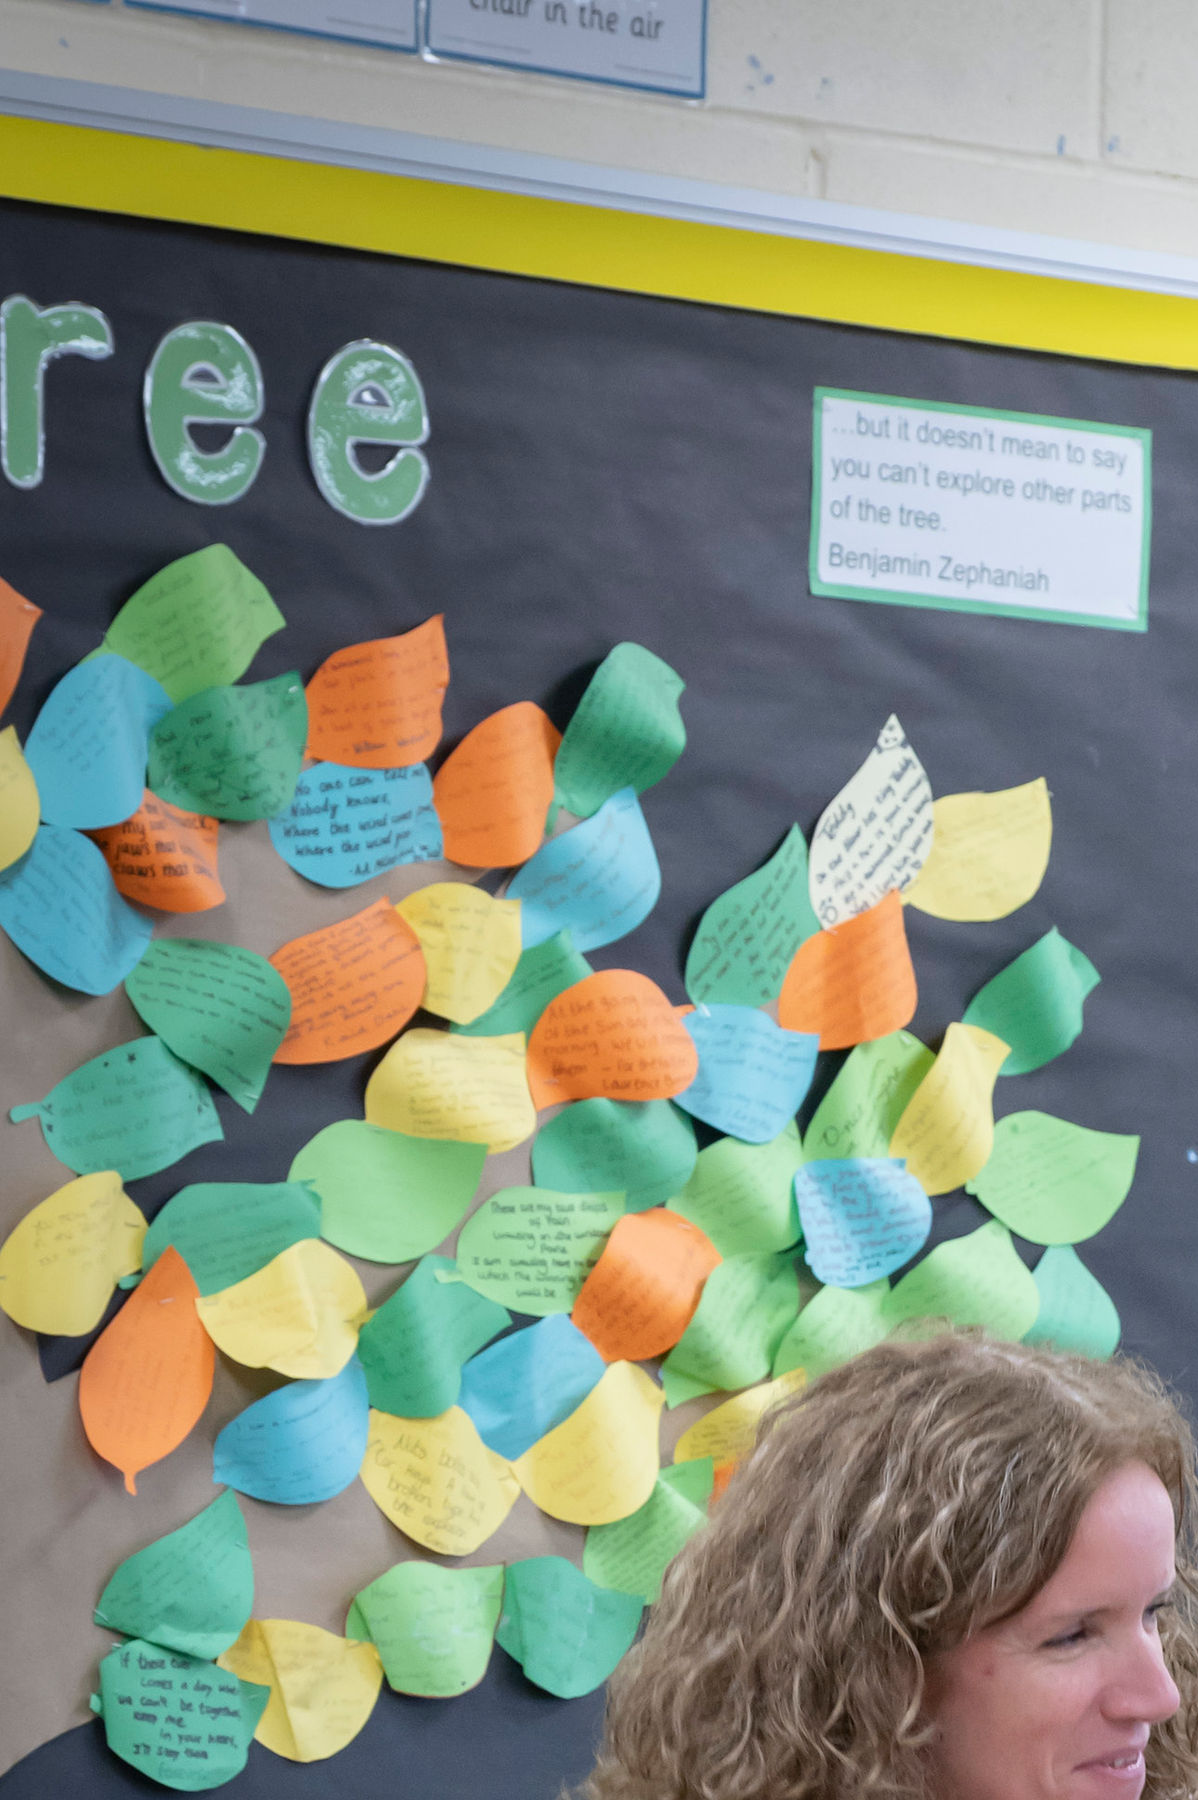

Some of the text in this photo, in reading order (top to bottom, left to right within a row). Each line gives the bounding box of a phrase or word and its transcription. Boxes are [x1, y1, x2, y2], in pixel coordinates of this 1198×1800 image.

[580, 0, 620, 34] the
[629, 11, 664, 39] air
[897, 416, 911, 441] it
[917, 421, 995, 453] doesn't
[1001, 435, 1060, 462] mean
[1065, 440, 1086, 465] to
[1091, 447, 1127, 476] say
[830, 456, 1133, 514] you can't explore other parts
[829, 495, 948, 533] of the tree.
[828, 542, 1050, 592] Benjamin Zephaniah
[291, 797, 339, 820] Nobody
